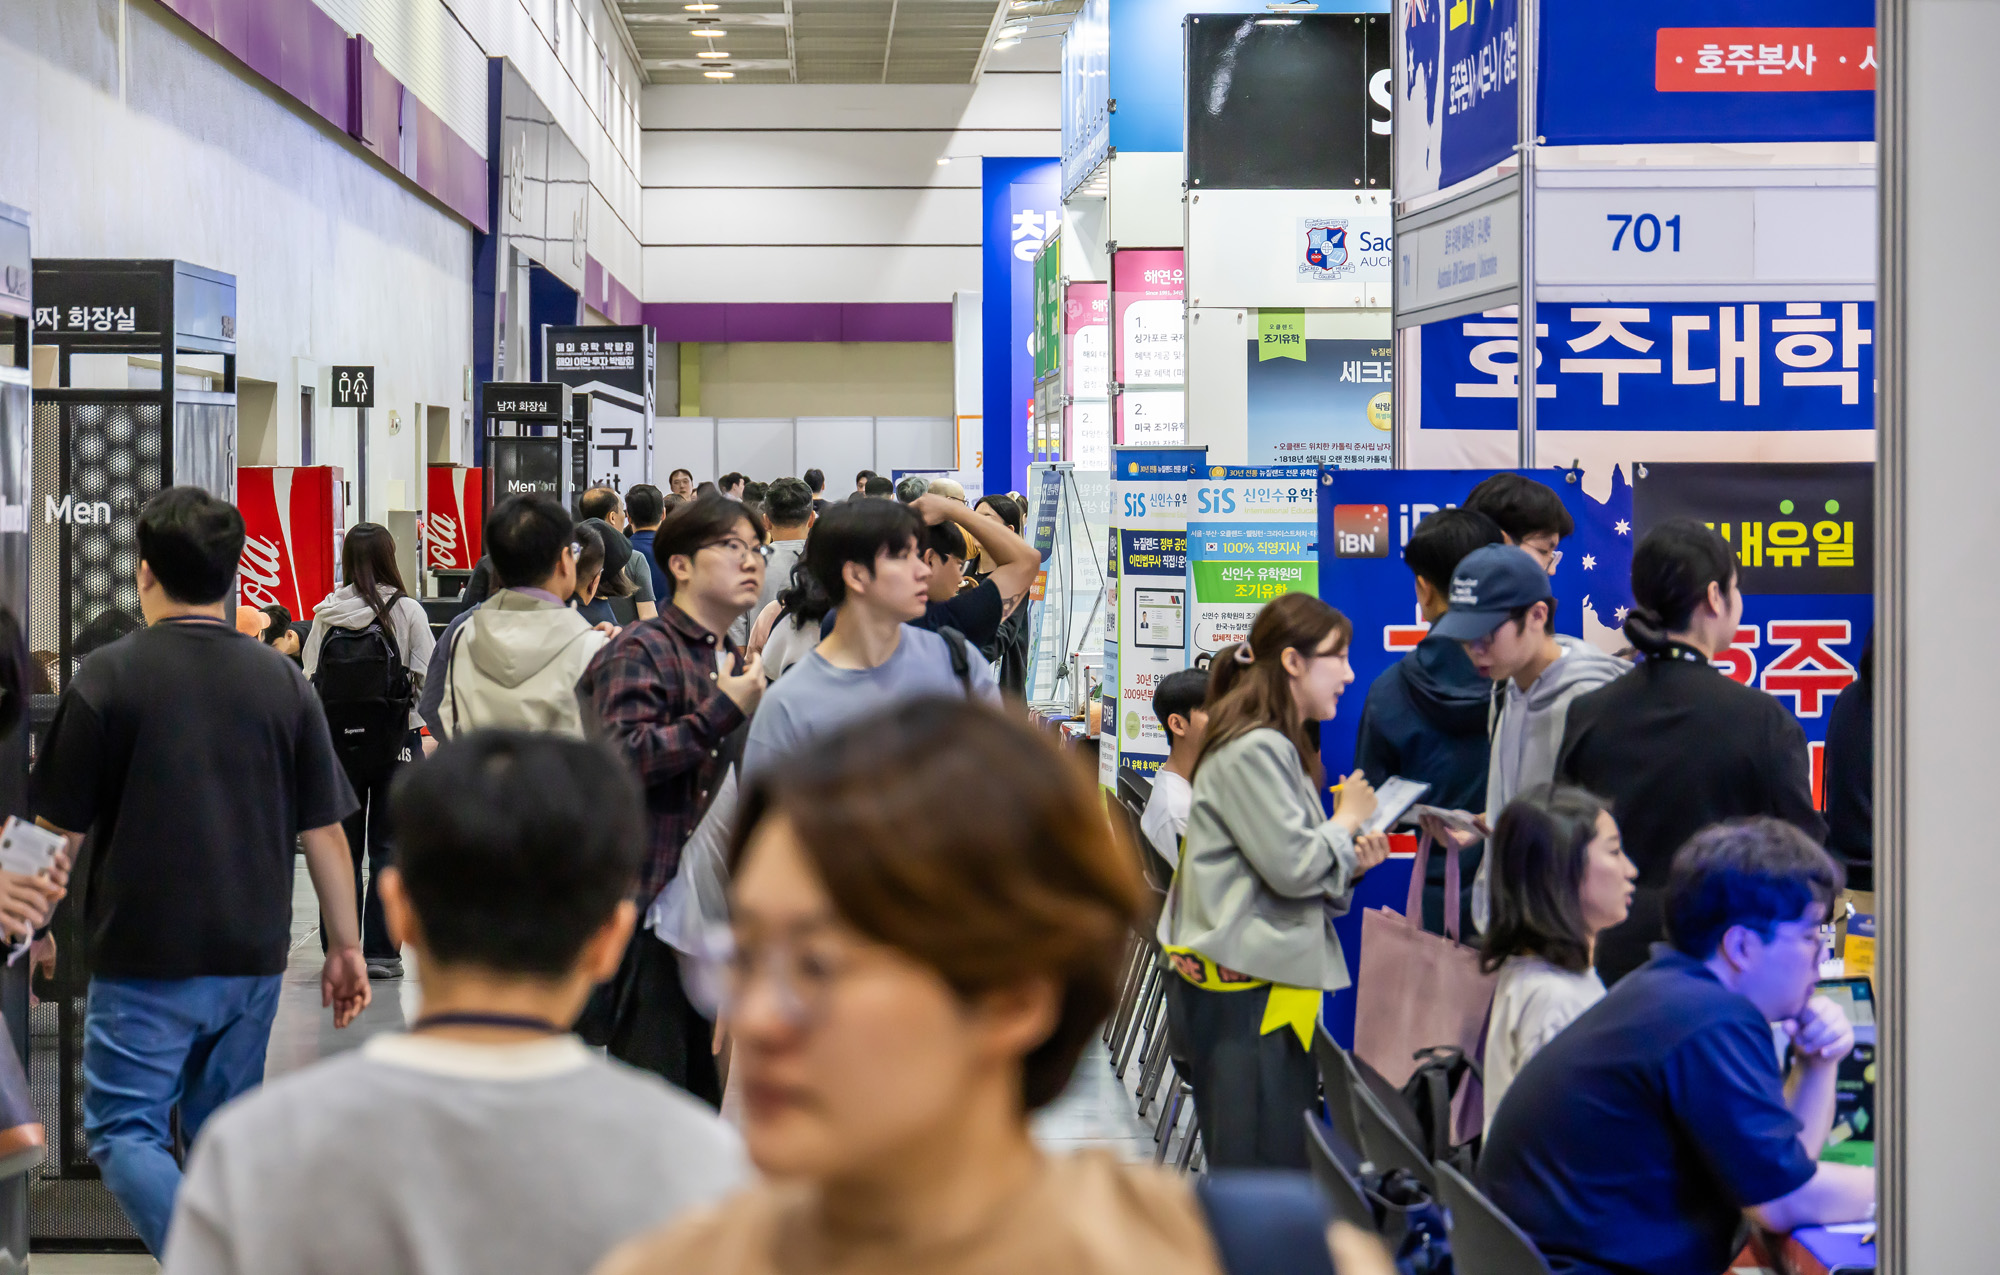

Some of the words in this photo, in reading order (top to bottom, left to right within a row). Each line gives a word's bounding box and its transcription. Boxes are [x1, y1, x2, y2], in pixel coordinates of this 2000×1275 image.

[1695, 44, 1817, 75] 호주본사
[1607, 214, 1681, 252] 701
[32, 306, 60, 331] 자
[67, 306, 135, 331] 화장실
[1135, 334, 1168, 343] 싱가포르
[1264, 334, 1300, 344] 조기유학
[497, 401, 516, 412] 남자
[518, 401, 547, 412] 화장실
[1134, 403, 1147, 416] 2.
[1134, 423, 1151, 432] 미국
[593, 428, 638, 467] 구
[1309, 443, 1330, 451] 위치한
[1344, 455, 1365, 463] 전통의
[1229, 469, 1244, 477] 30년
[1245, 469, 1258, 477] 전통
[1259, 468, 1284, 477] 뉴질랜드
[508, 480, 536, 493] Men
[1243, 488, 1318, 503] 신인수유학
[45, 495, 111, 524] Men
[1133, 538, 1159, 551] 뉴질랜드
[1160, 538, 1173, 551] 정부
[1222, 542, 1254, 554] 100%
[1257, 541, 1301, 555] 직영지사
[1338, 530, 1375, 553] iBN
[1221, 567, 1255, 580] 신인수
[1257, 567, 1302, 581] 유학원의
[1202, 612, 1219, 620] 신인수
[1221, 612, 1245, 620] 유학원의
[1136, 674, 1152, 686] 30년
[1131, 760, 1143, 770] 유학
